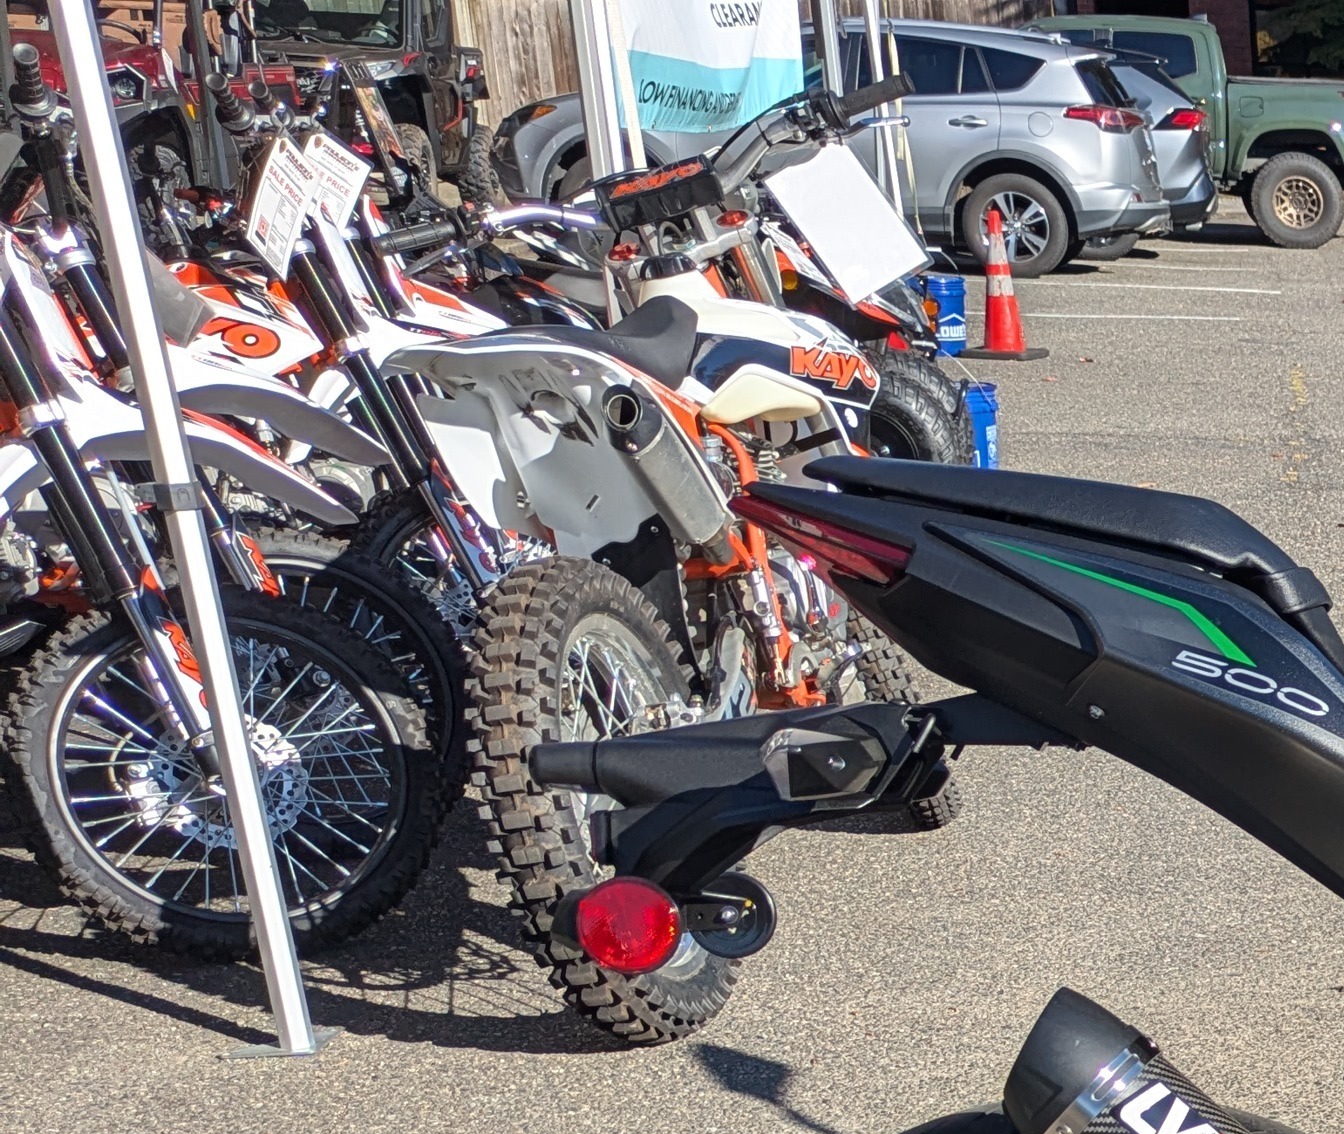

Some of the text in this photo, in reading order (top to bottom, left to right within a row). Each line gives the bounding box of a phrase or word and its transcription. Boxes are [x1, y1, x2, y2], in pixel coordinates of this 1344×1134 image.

[638, 78, 670, 106] LOW
[668, 85, 714, 112] FINANCING
[268, 165, 285, 187] SALE
[284, 183, 304, 207] PRICE
[326, 176, 351, 197] PRICE
[1171, 650, 1330, 716] 500
